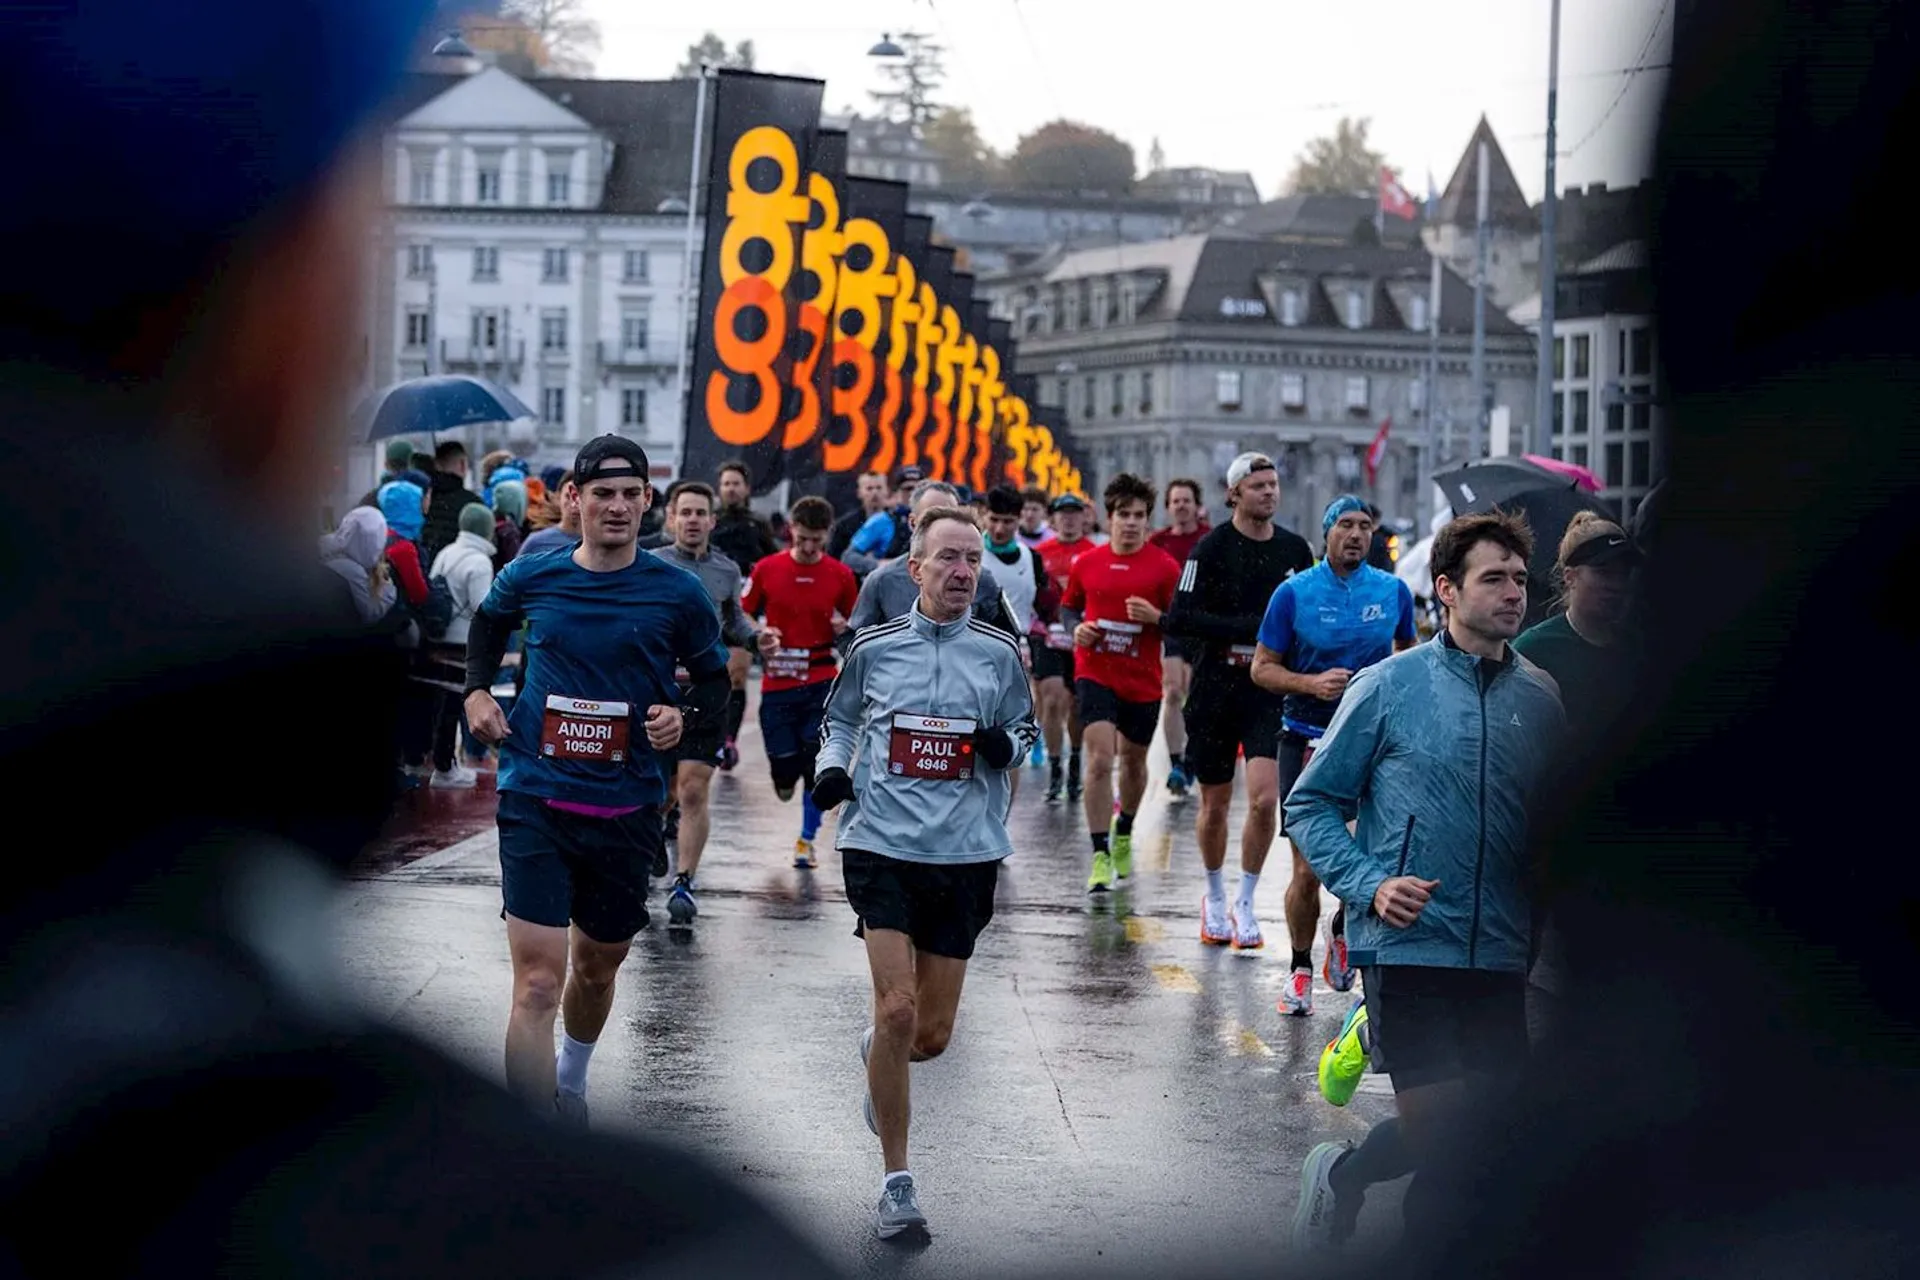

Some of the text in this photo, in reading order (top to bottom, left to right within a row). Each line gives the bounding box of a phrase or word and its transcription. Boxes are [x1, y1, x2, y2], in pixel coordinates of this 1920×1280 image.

[573, 701, 600, 711] coop
[558, 722, 612, 739] ANDRI
[922, 719, 949, 729] coop
[564, 740, 603, 754] 10562
[911, 740, 956, 757] PAUL
[916, 758, 948, 771] 4946
